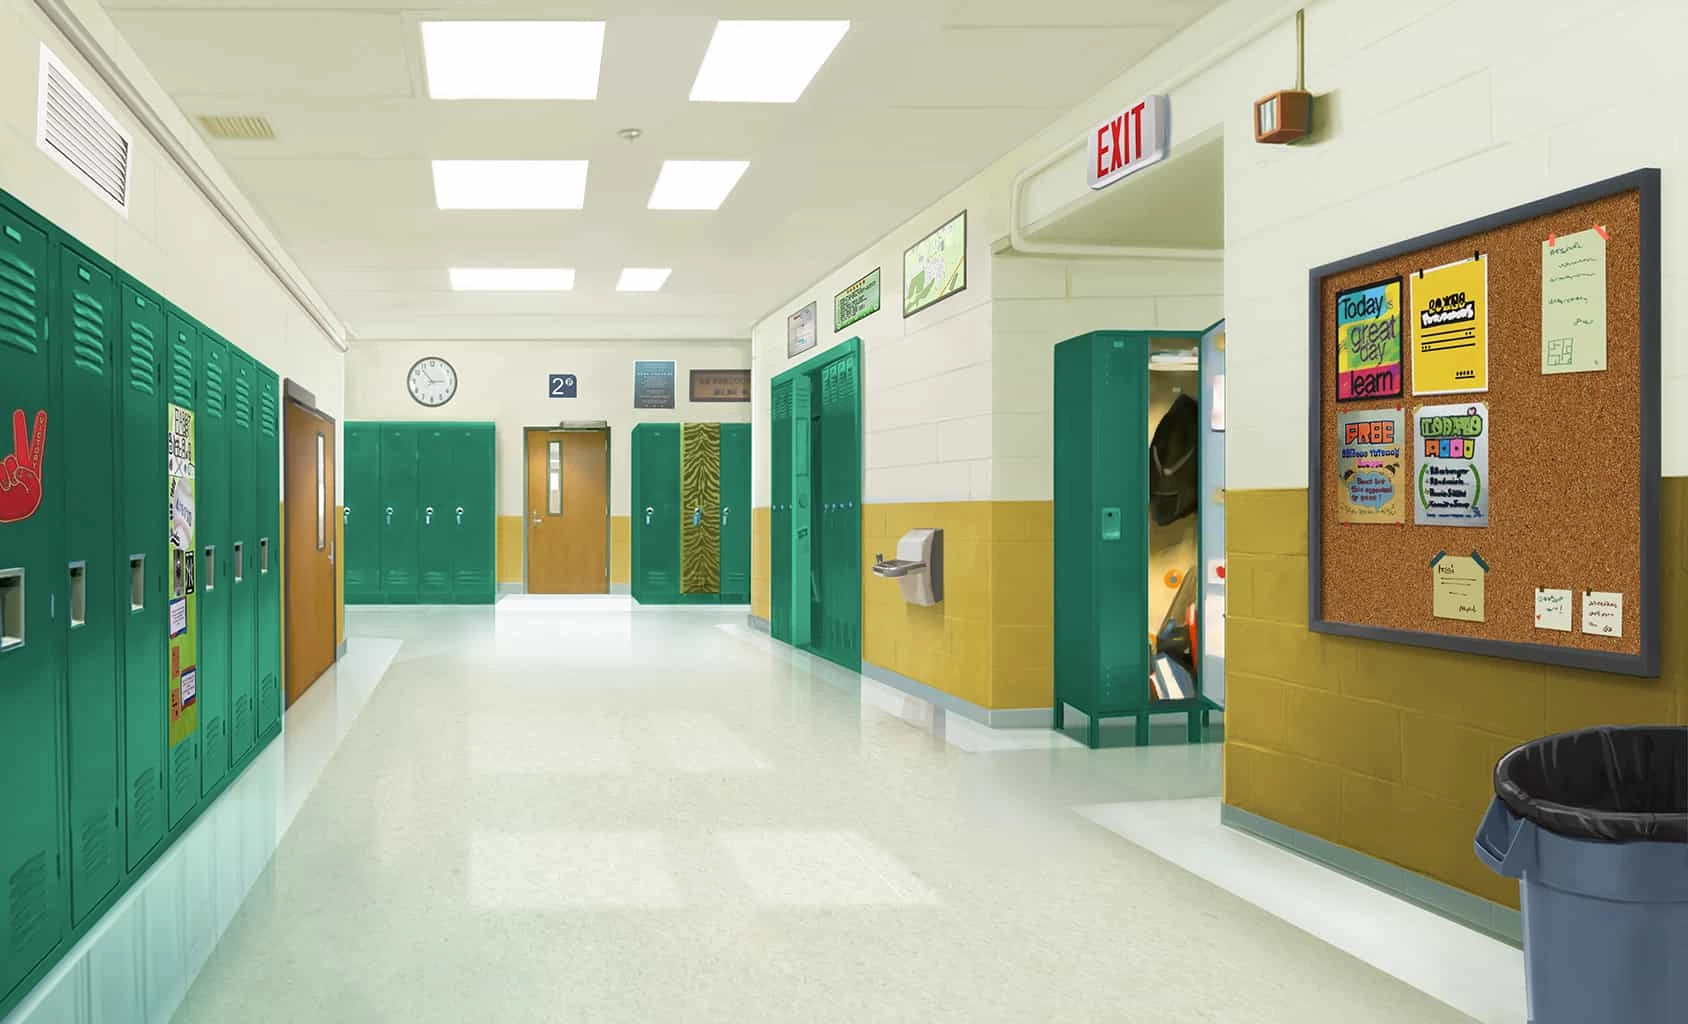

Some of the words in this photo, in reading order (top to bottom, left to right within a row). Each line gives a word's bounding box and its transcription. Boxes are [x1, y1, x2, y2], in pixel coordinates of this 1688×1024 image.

[1097, 101, 1145, 178] EXIT
[1339, 294, 1383, 319] Today
[1350, 315, 1397, 354] great
[1360, 342, 1386, 365] day
[1350, 370, 1393, 396] learn
[1345, 420, 1395, 445] FREE
